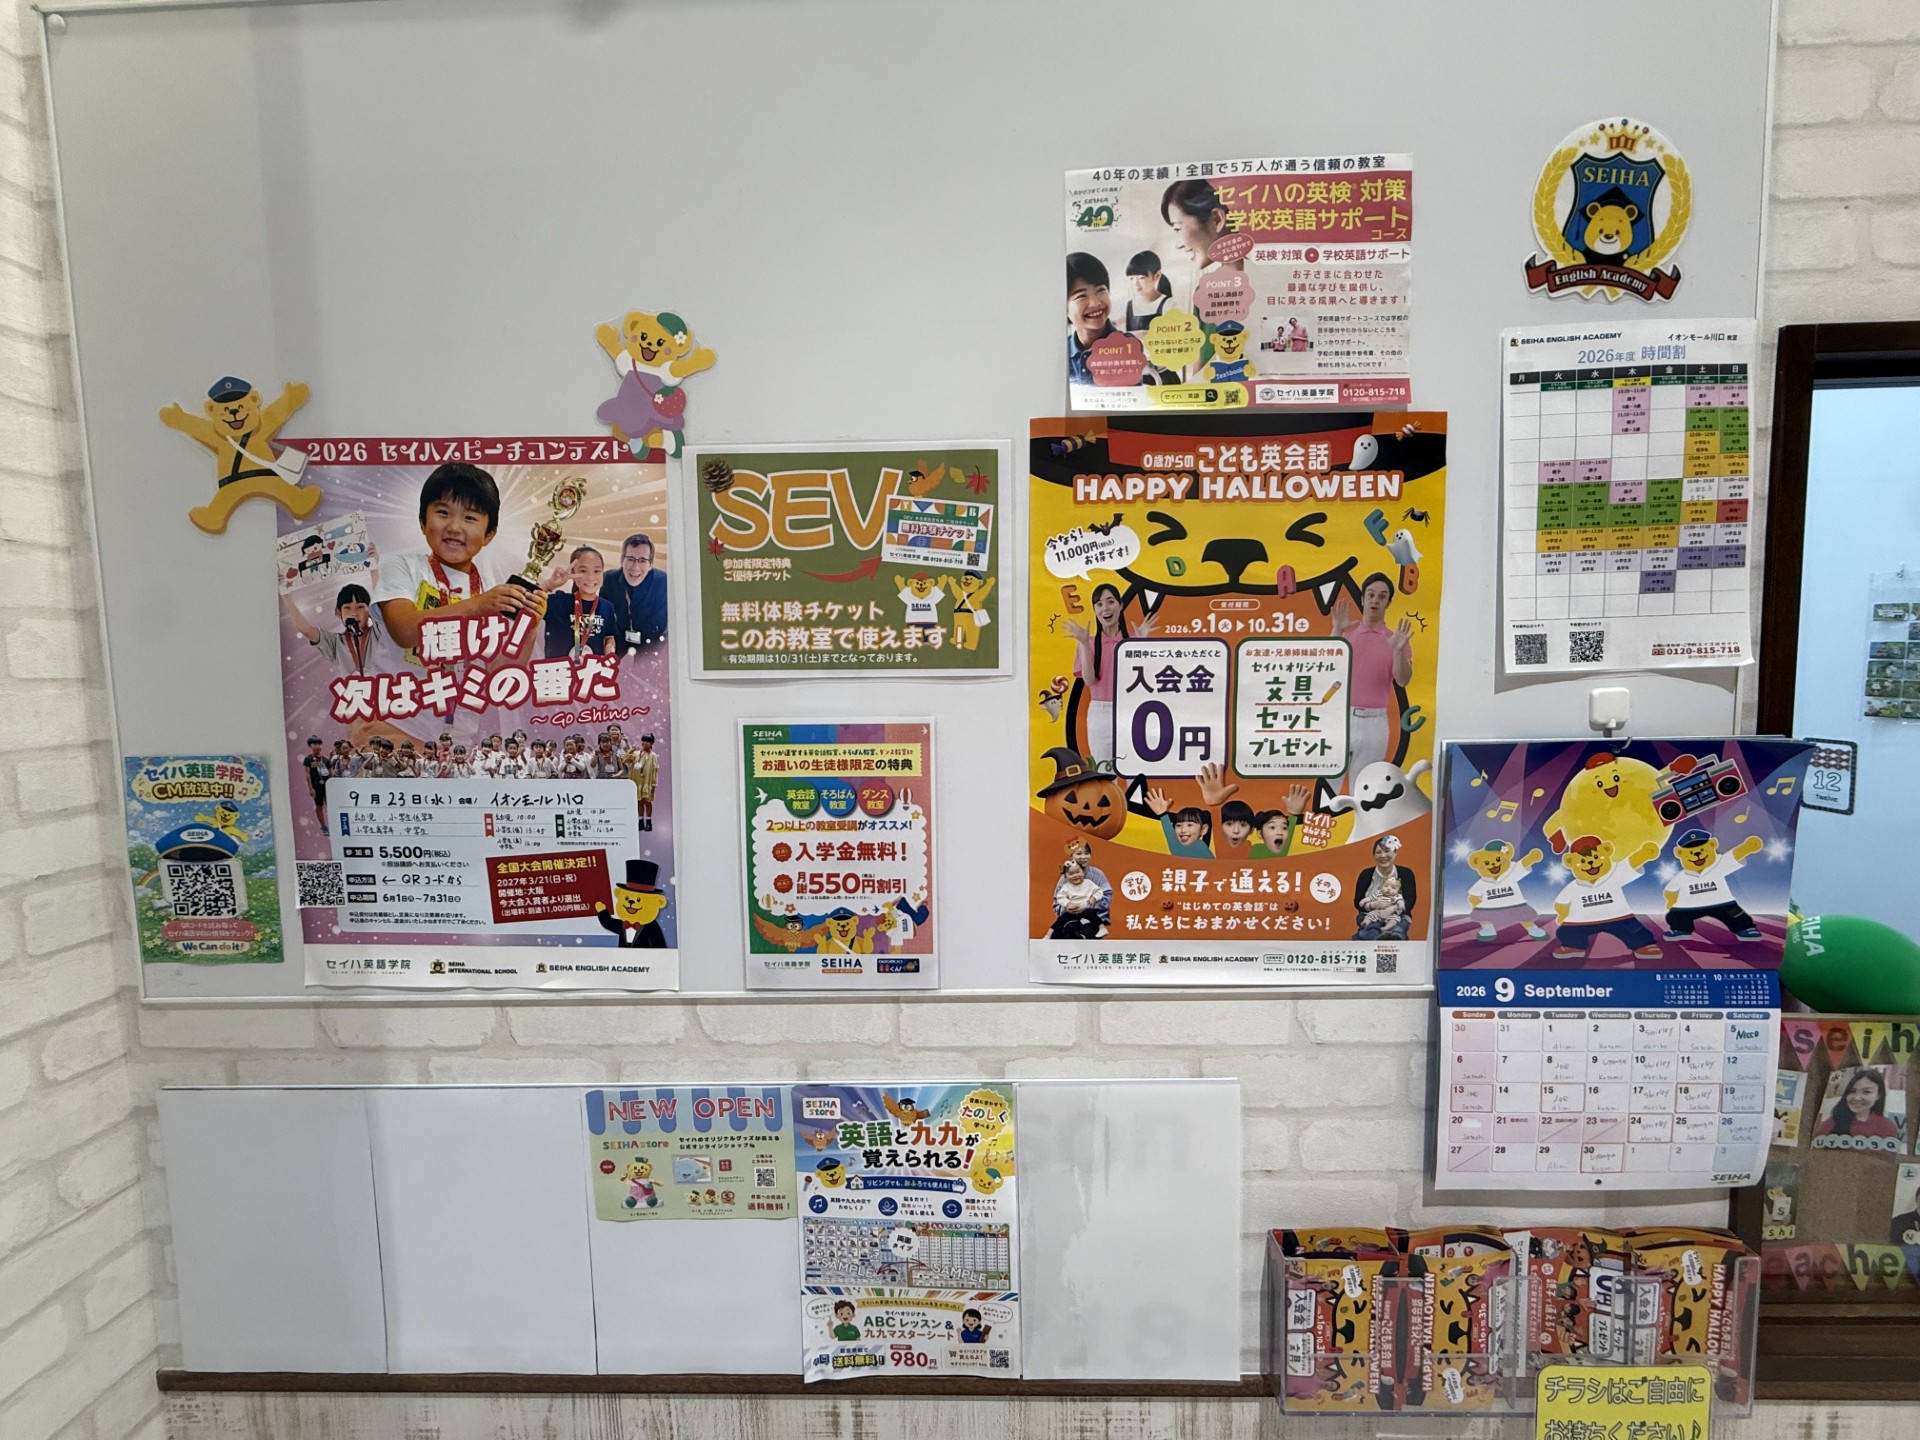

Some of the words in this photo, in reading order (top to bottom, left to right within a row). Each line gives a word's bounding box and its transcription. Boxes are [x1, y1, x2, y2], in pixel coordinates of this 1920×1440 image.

[1583, 167, 1650, 188] SEIHA
[1360, 179, 1407, 203] 対策
[1225, 206, 1409, 232] 学校英語サポート
[1371, 228, 1407, 240] コース
[1323, 248, 1410, 261] 学校英語サポート
[1292, 269, 1384, 280] お子さまに合わせた
[1555, 269, 1597, 288] English
[1600, 269, 1649, 293] Academy
[1206, 281, 1232, 289] POINT
[1233, 276, 1242, 288] 3
[1287, 283, 1384, 293] 最適な学びを提供し、
[1267, 295, 1407, 306] 目に見える成果へと導きます！
[1156, 325, 1182, 334] POINT
[1184, 322, 1192, 332] 2
[1520, 337, 1545, 345] SEIHA
[1546, 335, 1582, 343] ENGLISH
[1583, 332, 1623, 342] ACADEMY
[1667, 333, 1726, 342] イオンモール川口
[1098, 346, 1123, 355] POINT
[1126, 343, 1132, 354] 1
[1577, 348, 1636, 364] 2026年度
[1641, 345, 1687, 361] 時間割
[1215, 368, 1244, 380] Textbook
[1276, 388, 1335, 397] セイハ英語学院
[1342, 387, 1406, 397] 0120-815-718
[307, 442, 368, 462] 2026
[378, 440, 631, 463] セイハスピーチコンテスト
[1143, 454, 1193, 471] 0歳からの
[1196, 443, 1329, 473] こども英会話
[1075, 477, 1191, 503] HAPPY
[1202, 473, 1401, 500] HALLOWEEN
[708, 466, 904, 553] SEV
[1363, 508, 1390, 546] F
[1046, 526, 1084, 550] 今なら!
[1084, 545, 1130, 566] お得です!
[722, 556, 793, 570] 参加者限定特典
[1165, 555, 1186, 577] D
[722, 569, 793, 583] ご優待チケット
[1275, 564, 1297, 599] A
[1397, 562, 1419, 596] B
[1060, 583, 1084, 614] E
[1220, 600, 1250, 608] 受付期間
[720, 600, 885, 622] 無料体験チケット
[910, 602, 932, 610] SEIHA
[420, 615, 532, 663] 輝け!
[720, 626, 964, 651] このお教室で使えます！
[1124, 648, 1221, 660] 期間中にご入会いただくと
[1244, 647, 1345, 659] お友達・兄弟姉妹紹介特典
[1666, 646, 1741, 656] 0120-815-718
[721, 652, 920, 666] ※有効期限は10/31(土)までとなっております。
[1250, 661, 1336, 674] セイハオリジナル
[1125, 664, 1216, 694] 入会金
[334, 658, 618, 718] 次はキミの番だ
[1264, 675, 1313, 703] 文具
[551, 712, 574, 727] Go
[577, 706, 630, 722] Shine
[1255, 707, 1320, 730] セット
[751, 730, 783, 738] SEIHA
[1131, 700, 1212, 763] 0円
[1248, 739, 1332, 757] プレゼント
[761, 758, 913, 772] お通いの生徒様限定の特典
[143, 763, 245, 783] セイハ英語学院
[1812, 769, 1842, 792] 12
[152, 782, 235, 800] CM放送中!!
[786, 789, 816, 800] 英会話
[820, 789, 856, 800] そろばん
[861, 789, 889, 799] ダンス
[1815, 793, 1840, 803] twelve
[490, 791, 584, 807] イオンモール川口
[792, 800, 809, 810] 教室
[828, 800, 846, 810] 教室
[866, 800, 884, 810] 教室
[765, 819, 913, 832] 2つ以上の教室受講がオススメ!
[379, 846, 451, 859] 5,500円(税込)
[794, 841, 908, 862] 入学金無料！
[496, 855, 598, 875] 全国大会開催決定!!
[808, 872, 907, 894] 550円割引
[1160, 867, 1302, 895] 親子で通える!
[1688, 878, 1718, 893] SEIHA
[497, 887, 545, 898] 開催地：大阪
[1485, 884, 1514, 898] SEIHA
[1580, 889, 1614, 906] SEIHA
[499, 894, 582, 908] 今大会入賞者より選出
[1125, 914, 1332, 932] 私たちにおまかせください!
[182, 942, 198, 952] We
[199, 942, 217, 951] Can
[219, 943, 231, 951] do
[325, 958, 412, 970] セイハ英語学院
[821, 958, 863, 968] SEIHA
[1056, 952, 1151, 965] セイハ英語学院
[1169, 955, 1192, 963] SEIHA
[1193, 955, 1224, 963] ENGLISH
[1224, 955, 1259, 963] ACADEMY
[1286, 953, 1367, 965] 0120-815-718
[447, 967, 493, 975] INTERNATIONAL
[549, 964, 574, 972] SEIHA
[575, 965, 610, 973] ENGLISH
[611, 965, 650, 974] ACADEMY
[1455, 985, 1486, 998] 2026
[1494, 977, 1515, 1002] 9
[1523, 984, 1614, 999] September
[1462, 1011, 1487, 1019] Sunday
[1506, 1011, 1532, 1019] Monday
[1551, 1011, 1578, 1019] Tuesday
[1590, 1011, 1629, 1019] Wednesday
[1640, 1012, 1671, 1020] Thursday
[1691, 1012, 1714, 1020] Friday
[1732, 1012, 1764, 1020] Saturday
[607, 1098, 678, 1121] NEW
[693, 1097, 775, 1119] OPEN
[805, 1099, 838, 1109] SEIHA
[808, 1108, 836, 1117] store
[961, 1105, 1007, 1124] たのしく
[838, 1120, 980, 1149] 英語と九九が
[602, 1139, 639, 1150] SEIHA
[640, 1139, 670, 1150] store
[1815, 1137, 1898, 1150] Uyanga
[861, 1148, 976, 1171] 覚えられる!
[1710, 1173, 1752, 1181] SEIHA
[820, 1257, 875, 1279] SAMPLE
[930, 1263, 988, 1283] SAMPLE
[1709, 1263, 1727, 1309] HAPPY
[1423, 1272, 1436, 1342] HALLOWEEN
[863, 1328, 955, 1342] 九九マスターシート
[832, 1354, 885, 1369] 送料無料！
[889, 1350, 938, 1369] 980円
[1422, 1344, 1434, 1392] HAPPY
[1544, 1374, 1706, 1405] チラシはご自由に
